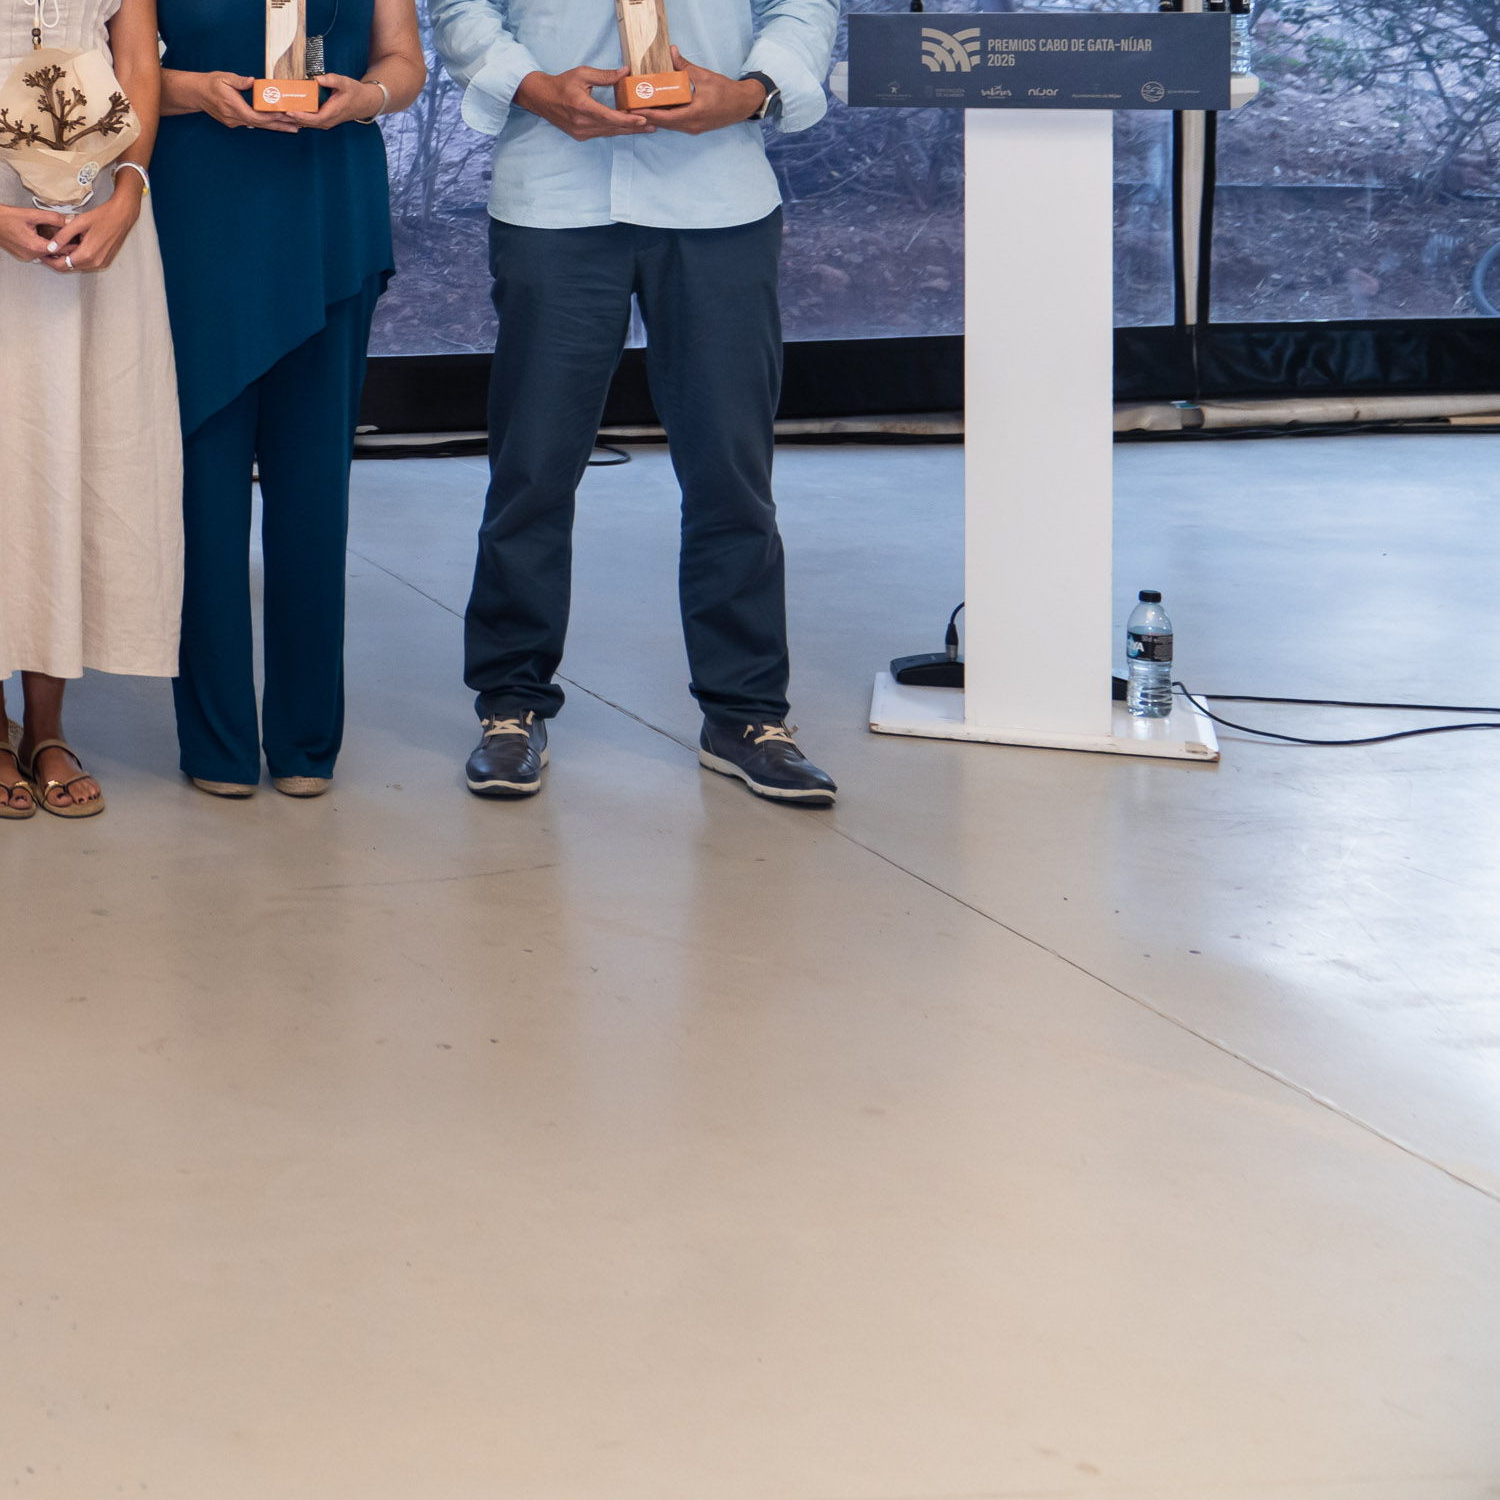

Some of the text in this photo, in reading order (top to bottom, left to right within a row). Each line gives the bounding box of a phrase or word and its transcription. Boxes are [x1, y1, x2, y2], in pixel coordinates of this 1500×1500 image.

[987, 36, 1152, 51] PREMIOS CABO DE GATA-NÍJAR
[987, 54, 1015, 66] 2026
